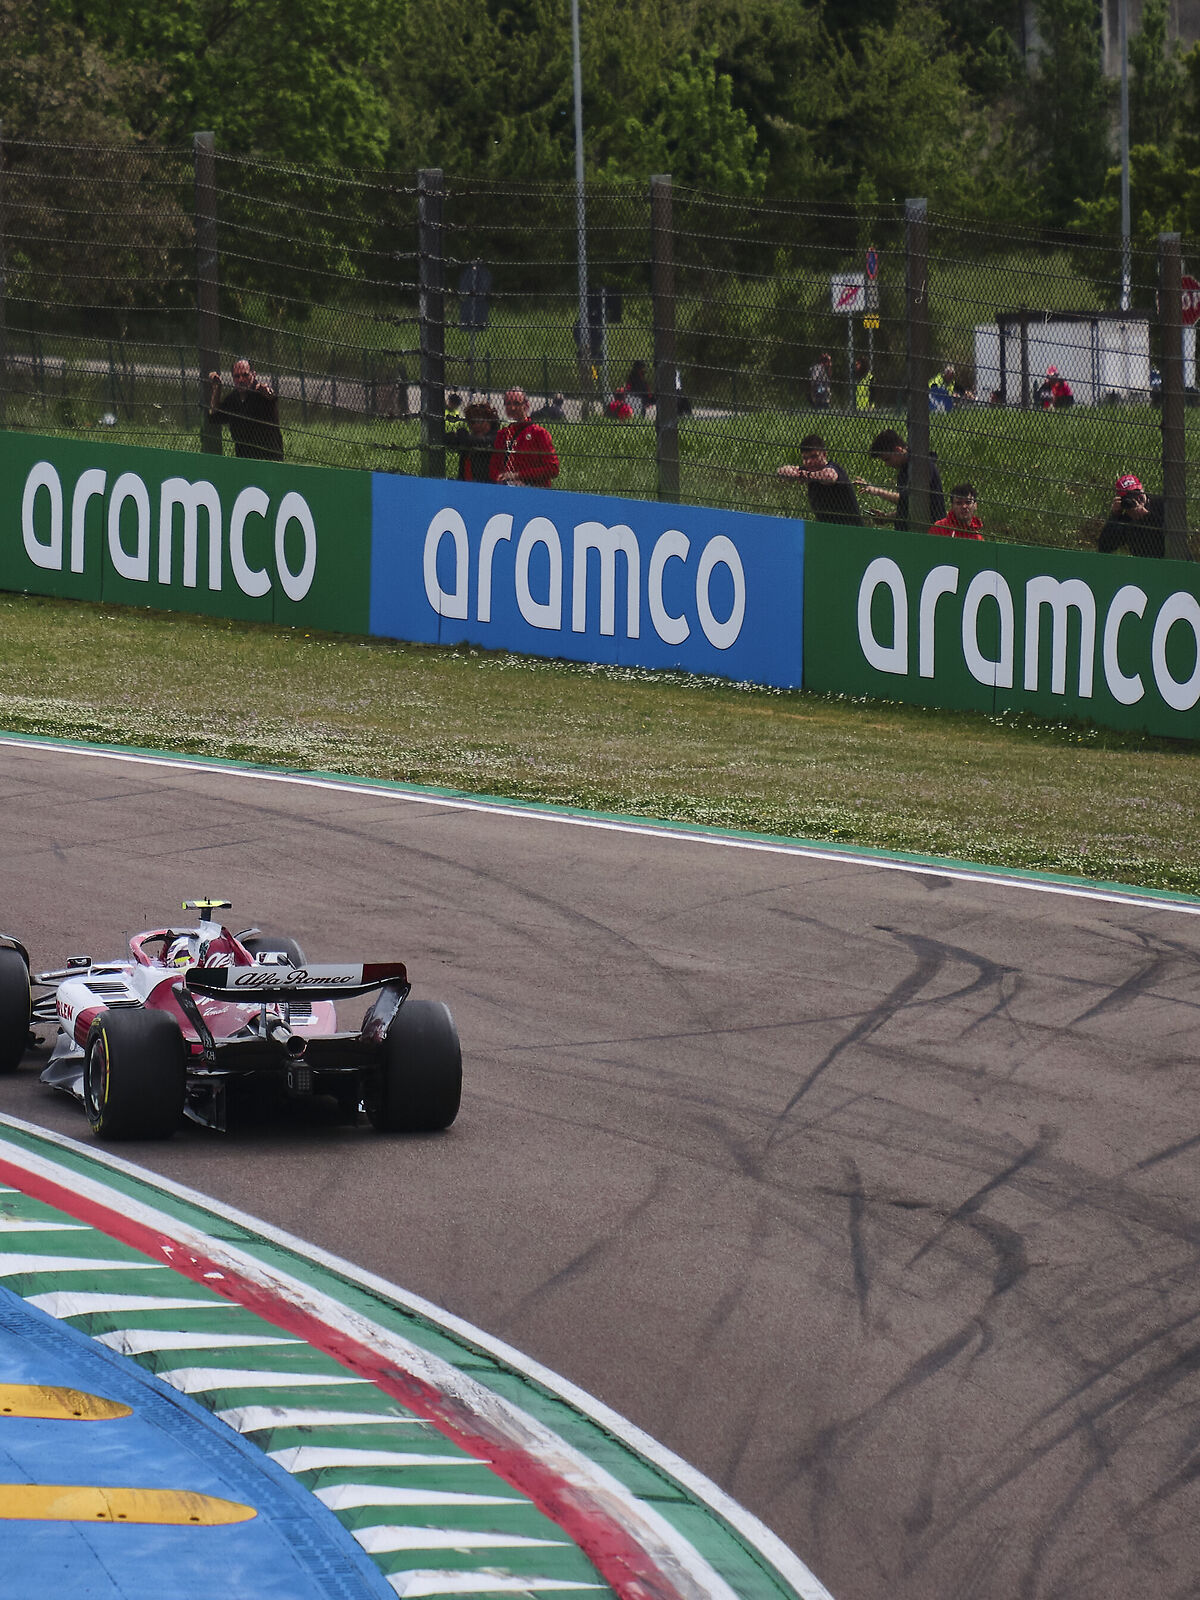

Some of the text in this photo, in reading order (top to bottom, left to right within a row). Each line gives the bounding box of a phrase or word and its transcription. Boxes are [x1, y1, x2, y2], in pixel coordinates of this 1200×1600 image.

[21, 461, 317, 602] aramco
[423, 507, 746, 650] aramco
[857, 557, 1200, 711] aramco
[56, 1000, 75, 1022] RLEN
[234, 969, 355, 988] Alfa Romeo
